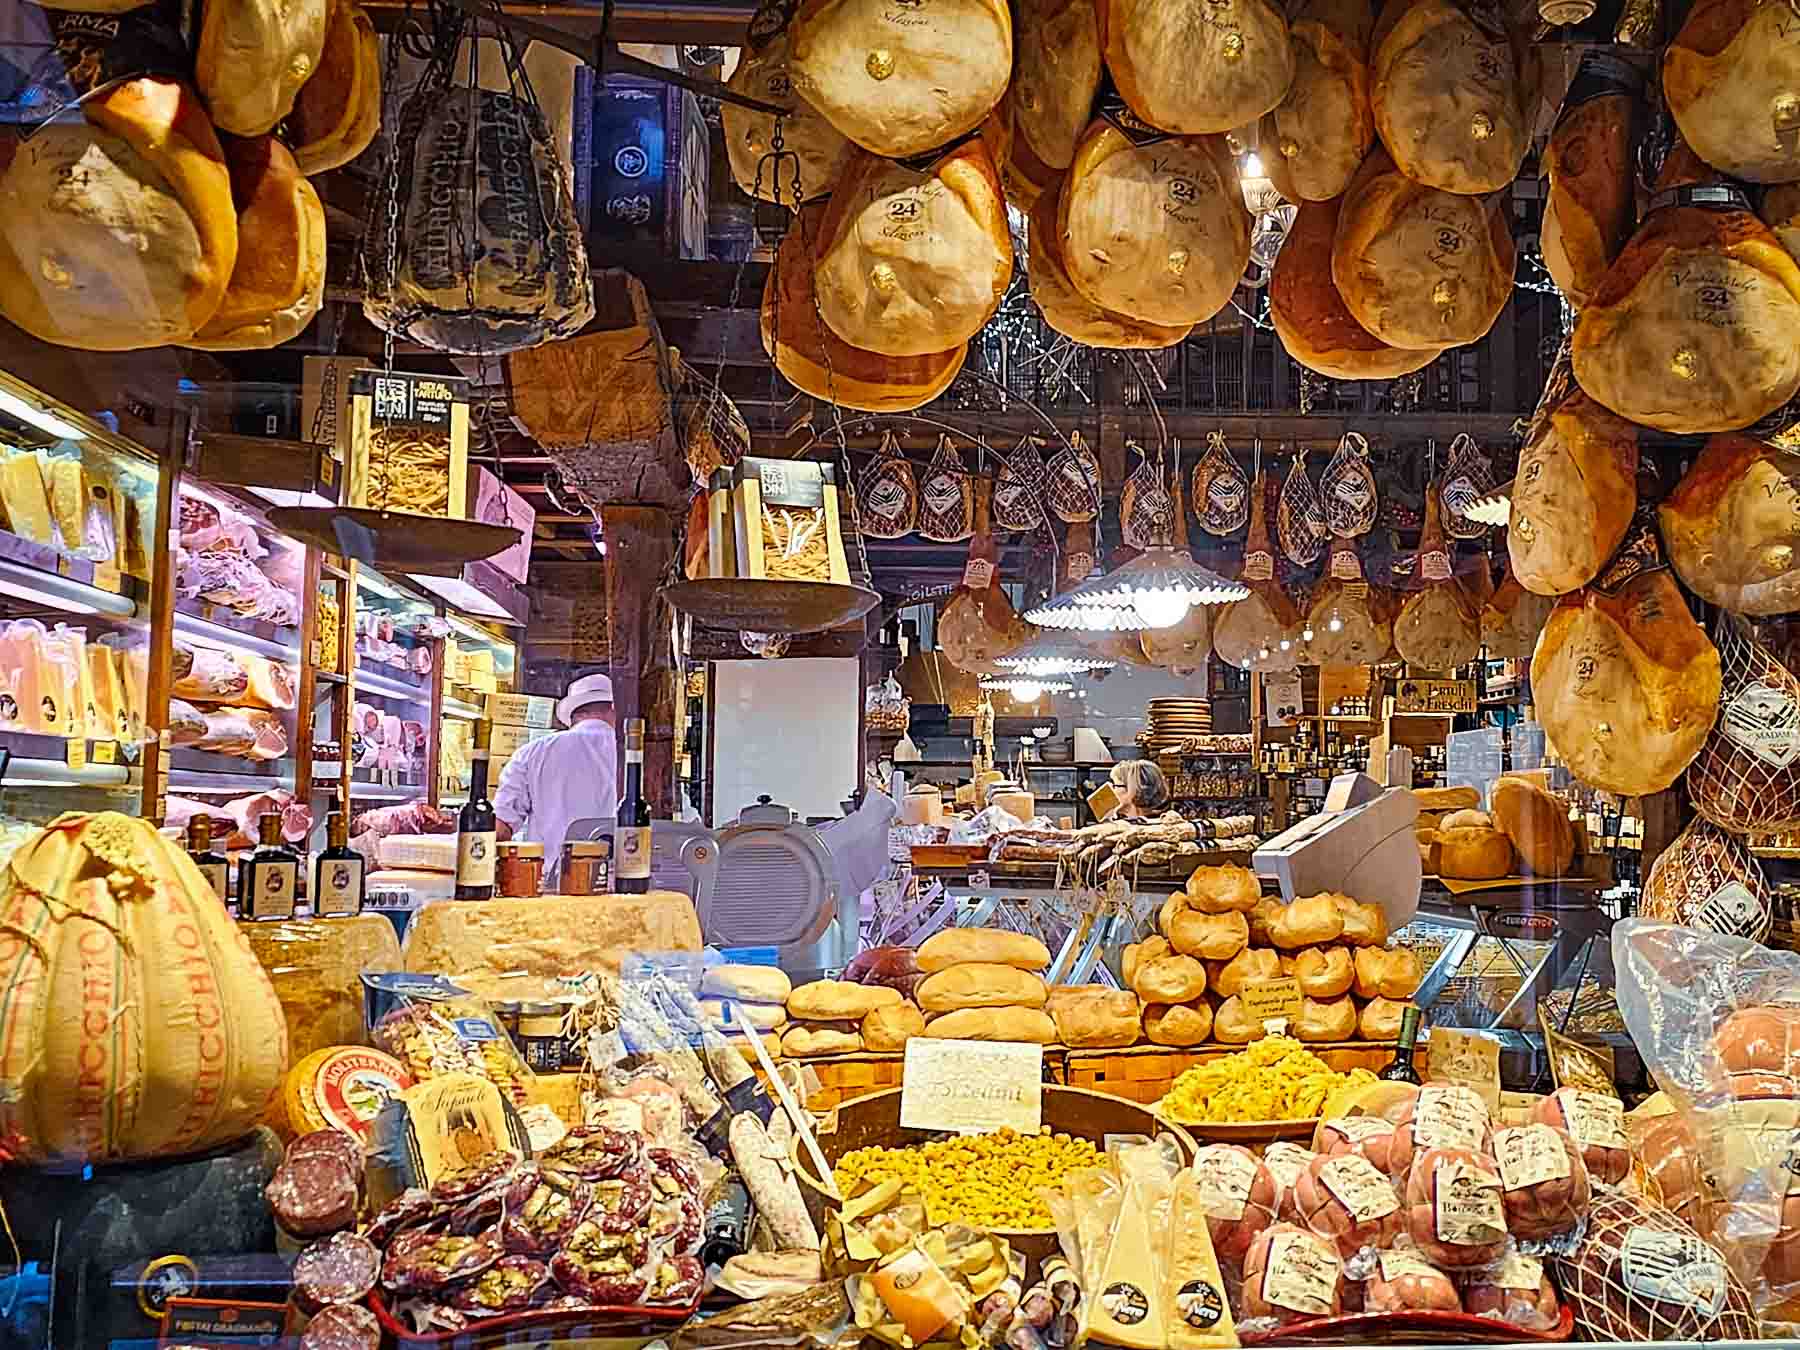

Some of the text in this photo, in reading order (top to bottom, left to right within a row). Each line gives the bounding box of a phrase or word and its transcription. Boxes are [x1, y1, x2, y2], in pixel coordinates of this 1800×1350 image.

[1173, 182, 1195, 200] 24
[891, 202, 918, 216] 24
[1439, 231, 1459, 249] 24
[1702, 290, 1729, 304] 24
[415, 388, 452, 400] TARTUFO
[1577, 660, 1594, 675] 24
[325, 1056, 401, 1088] MOLITERNO
